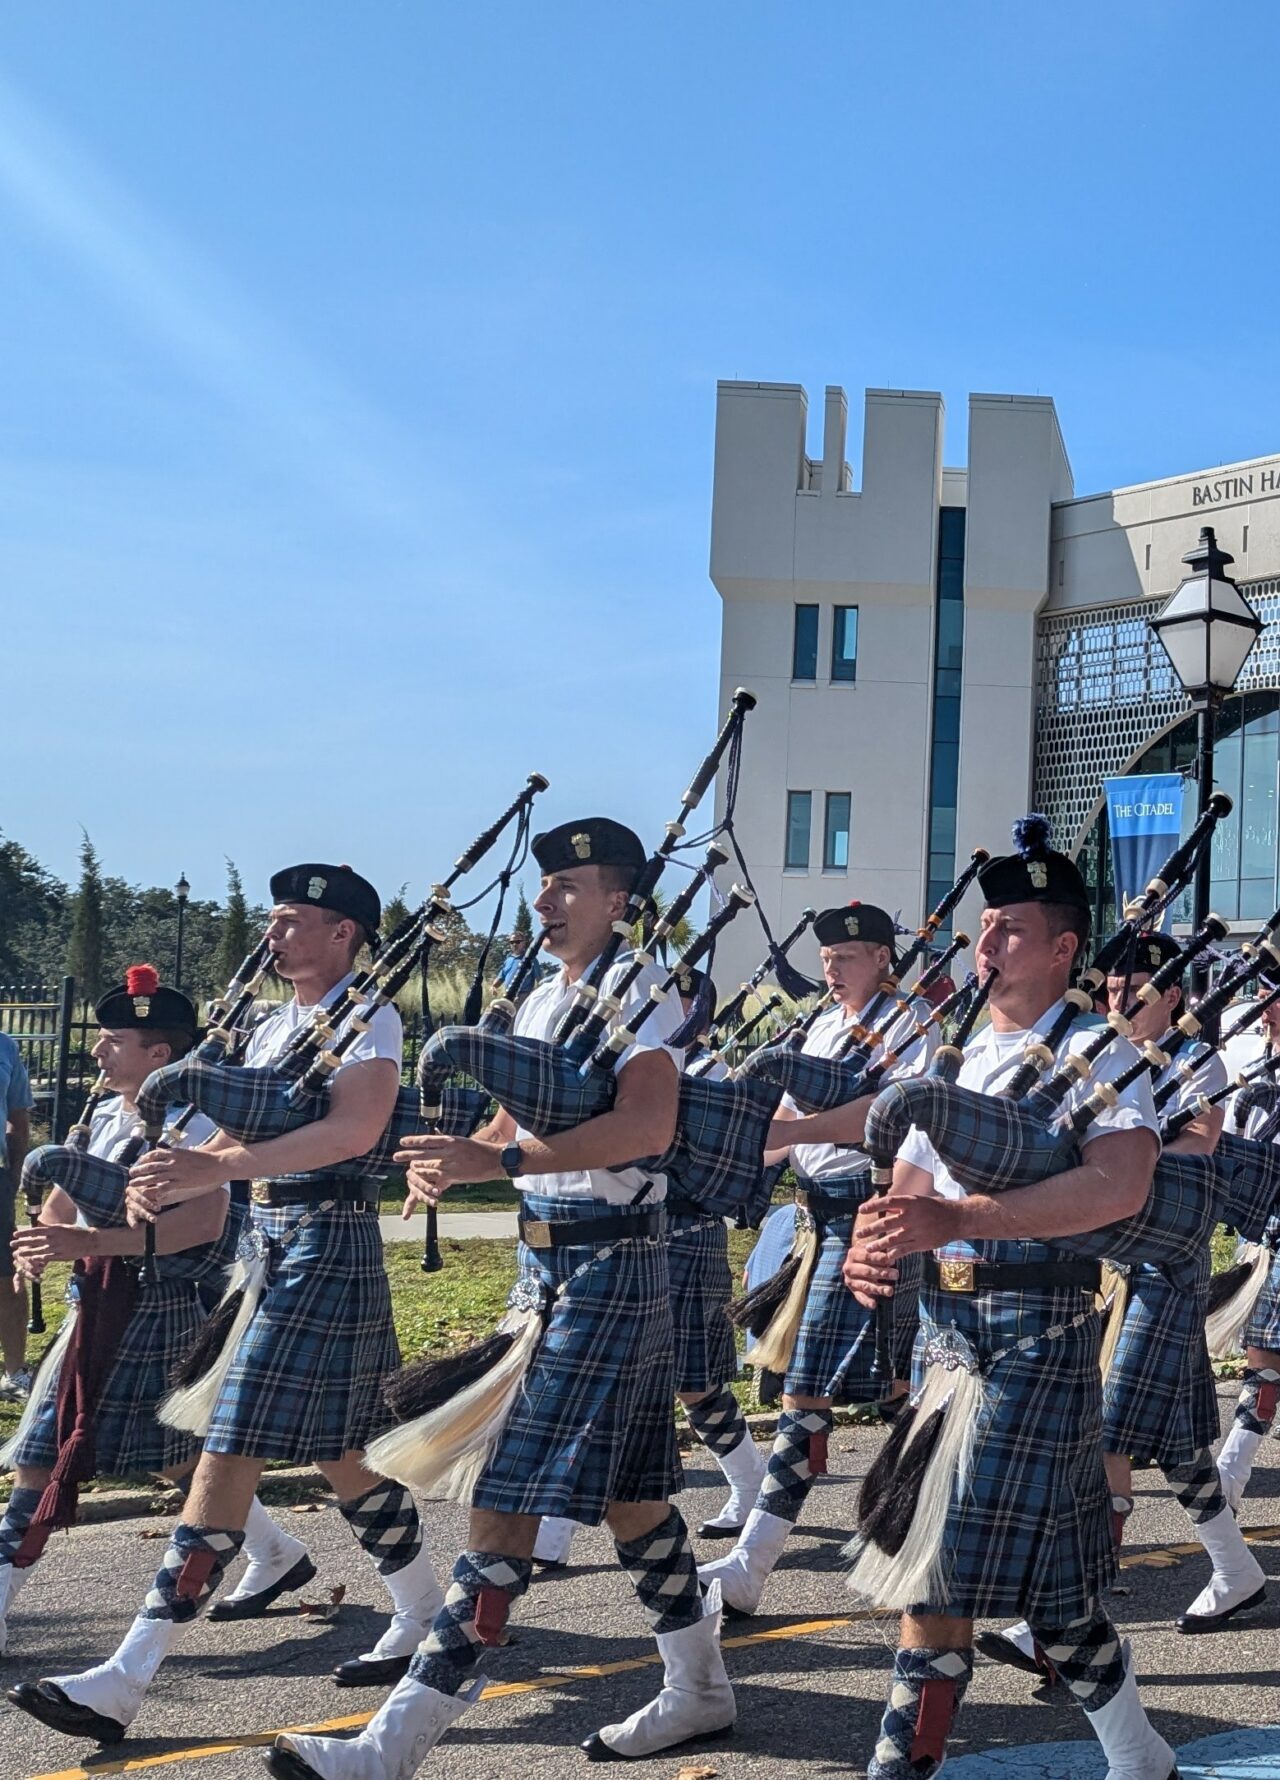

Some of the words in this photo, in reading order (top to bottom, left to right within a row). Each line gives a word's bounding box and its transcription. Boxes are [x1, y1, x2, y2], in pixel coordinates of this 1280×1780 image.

[1193, 474, 1254, 506] BASTIN
[1113, 804, 1133, 818] THE
[1134, 802, 1176, 817] CITADEL
